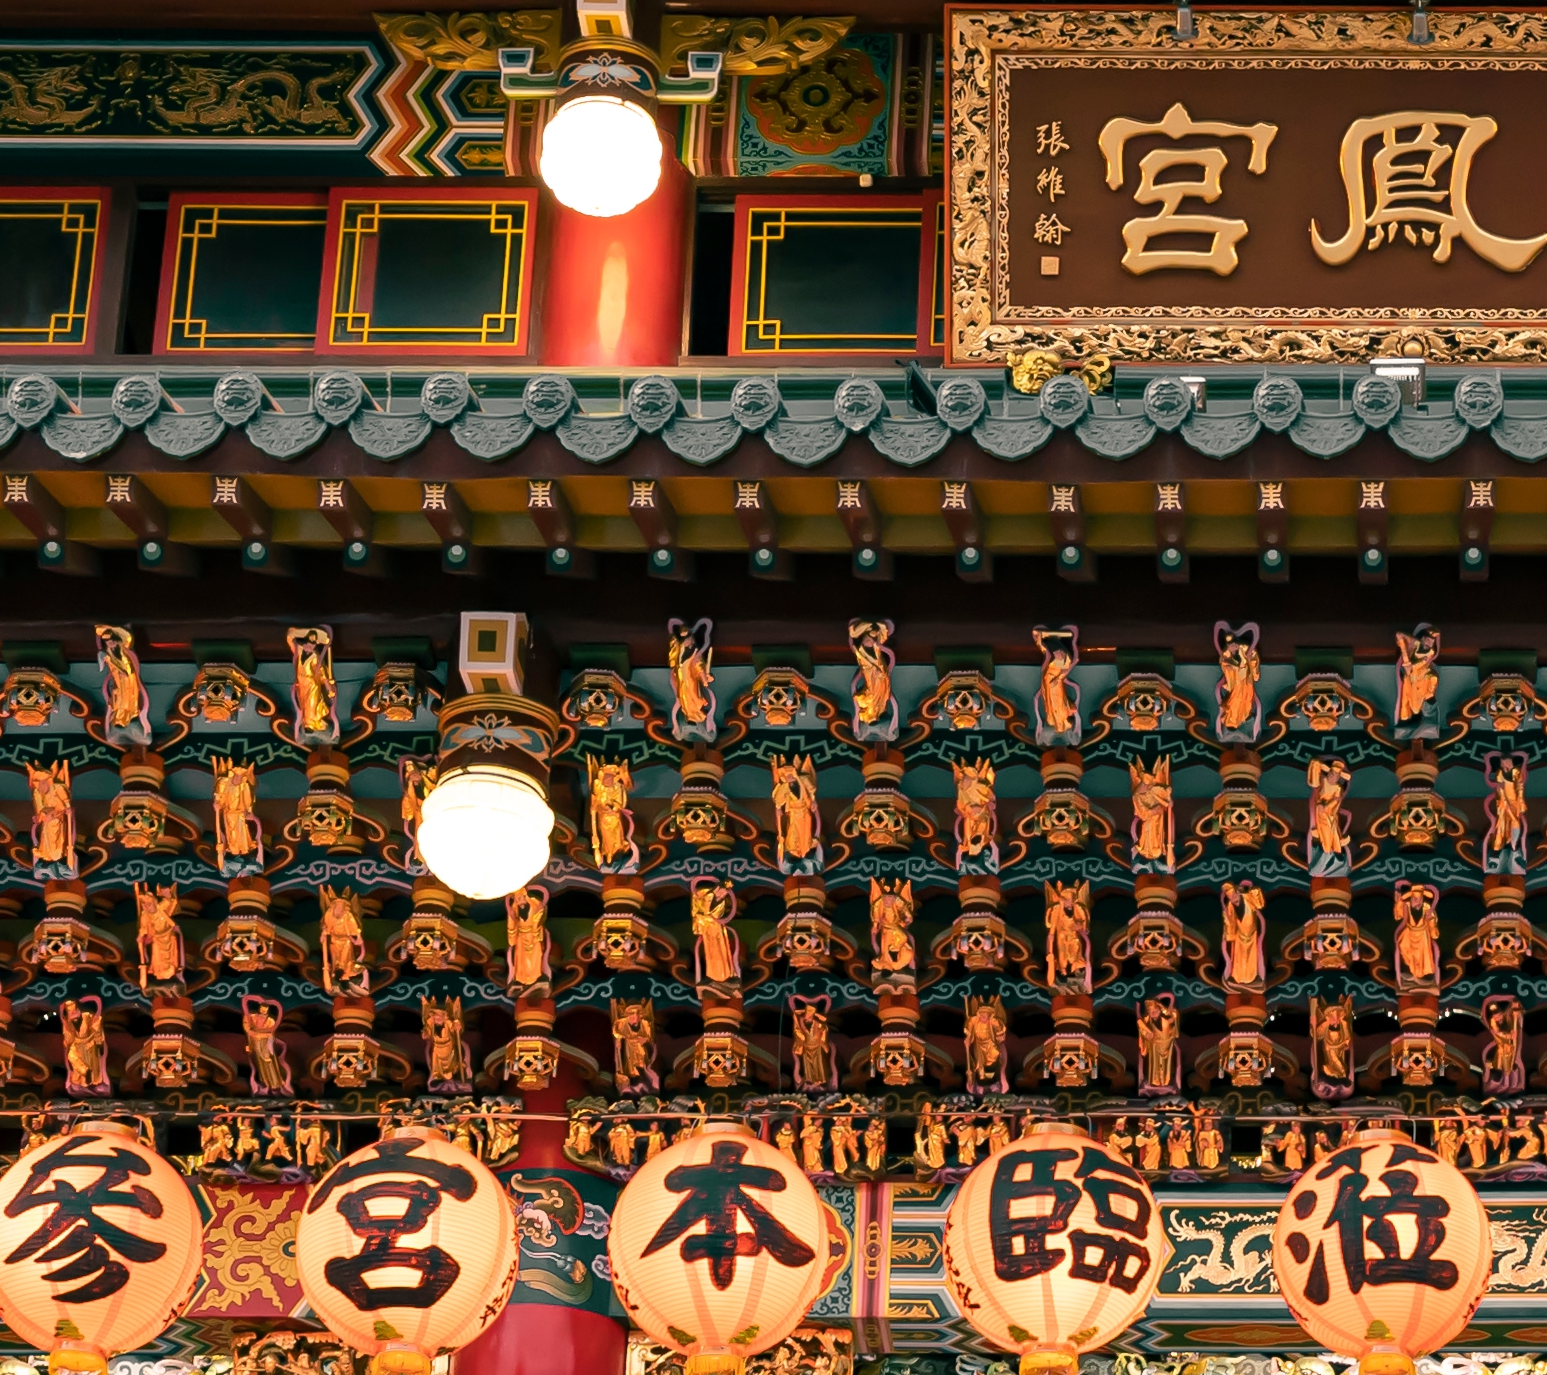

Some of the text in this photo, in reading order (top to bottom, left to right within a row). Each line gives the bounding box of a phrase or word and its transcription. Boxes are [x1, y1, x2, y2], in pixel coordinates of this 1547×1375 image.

[3, 1135, 167, 1304] 參
[307, 1137, 478, 1311] 宮
[639, 1140, 816, 1292] 本
[990, 1146, 1153, 1295] 臨
